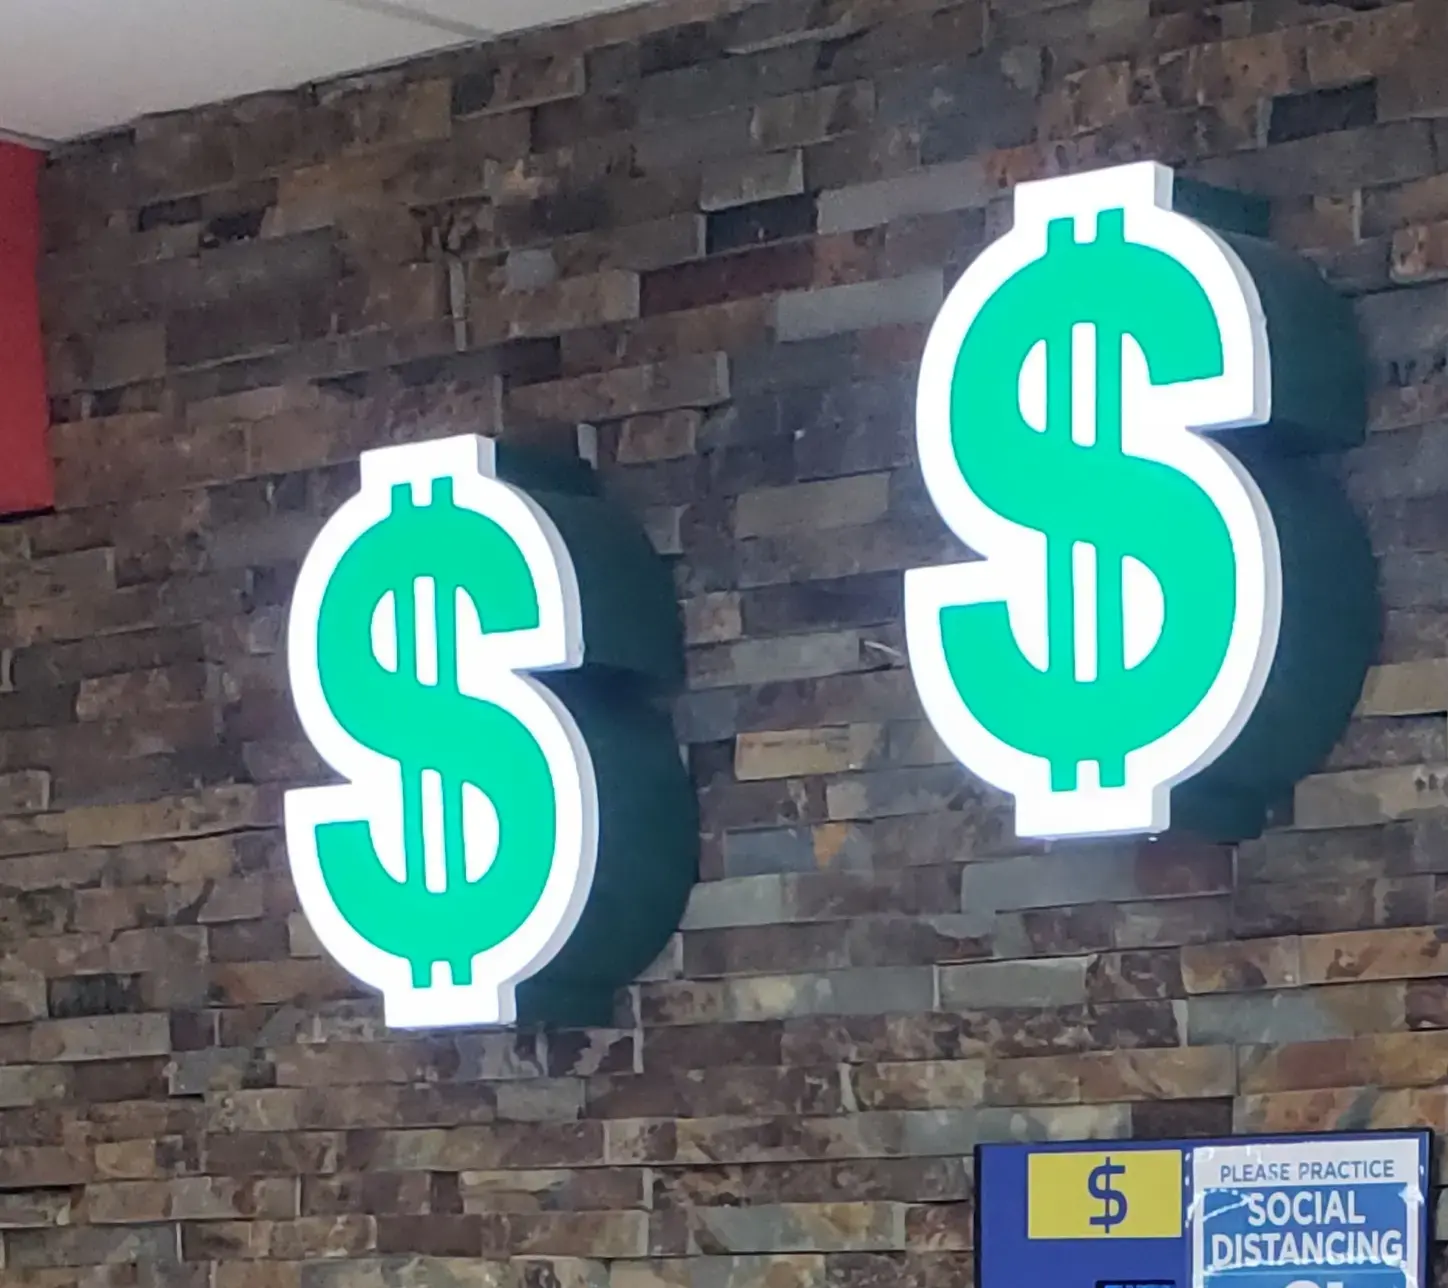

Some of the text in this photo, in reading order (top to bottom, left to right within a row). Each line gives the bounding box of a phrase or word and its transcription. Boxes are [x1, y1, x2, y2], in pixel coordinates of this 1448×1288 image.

[906, 160, 1284, 838] $
[284, 435, 598, 1027] $
[1088, 1156, 1128, 1234] $
[1220, 1160, 1395, 1183] PLEASE PRACTICE
[1247, 1190, 1366, 1226] SOCIAL
[1211, 1230, 1403, 1269] DISTANCING
